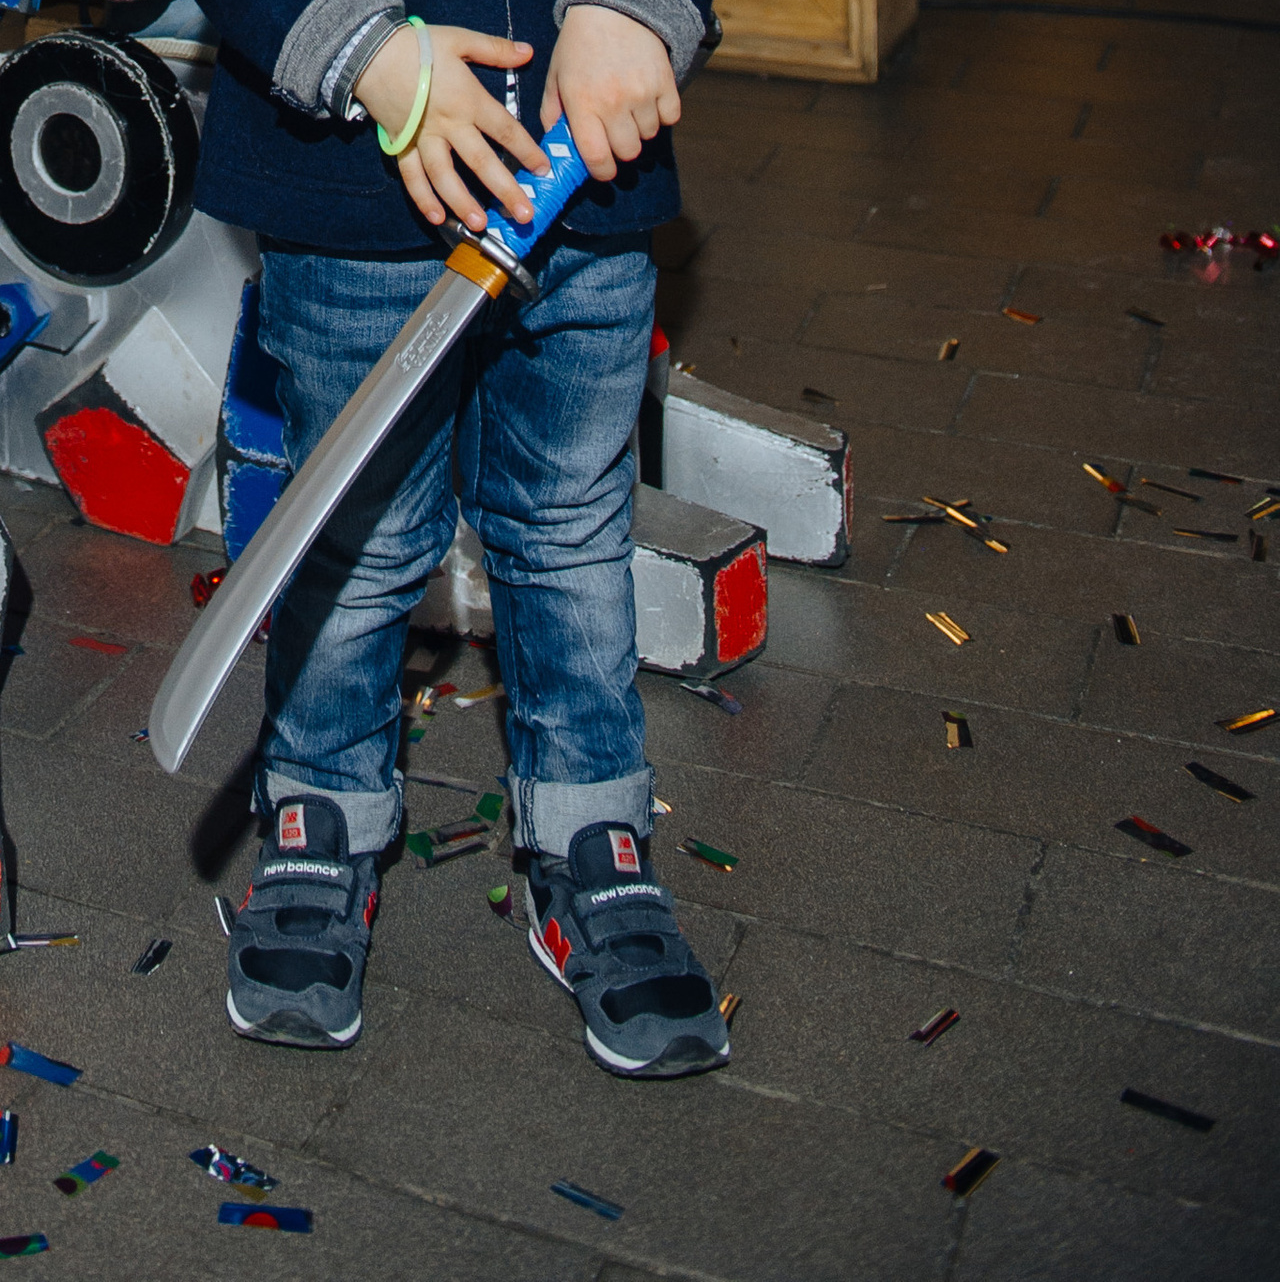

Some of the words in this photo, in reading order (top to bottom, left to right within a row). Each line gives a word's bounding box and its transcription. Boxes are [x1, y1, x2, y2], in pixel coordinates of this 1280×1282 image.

[264, 863, 286, 876] new
[287, 861, 339, 877] balance
[591, 888, 617, 904] new
[616, 883, 661, 896] balance
